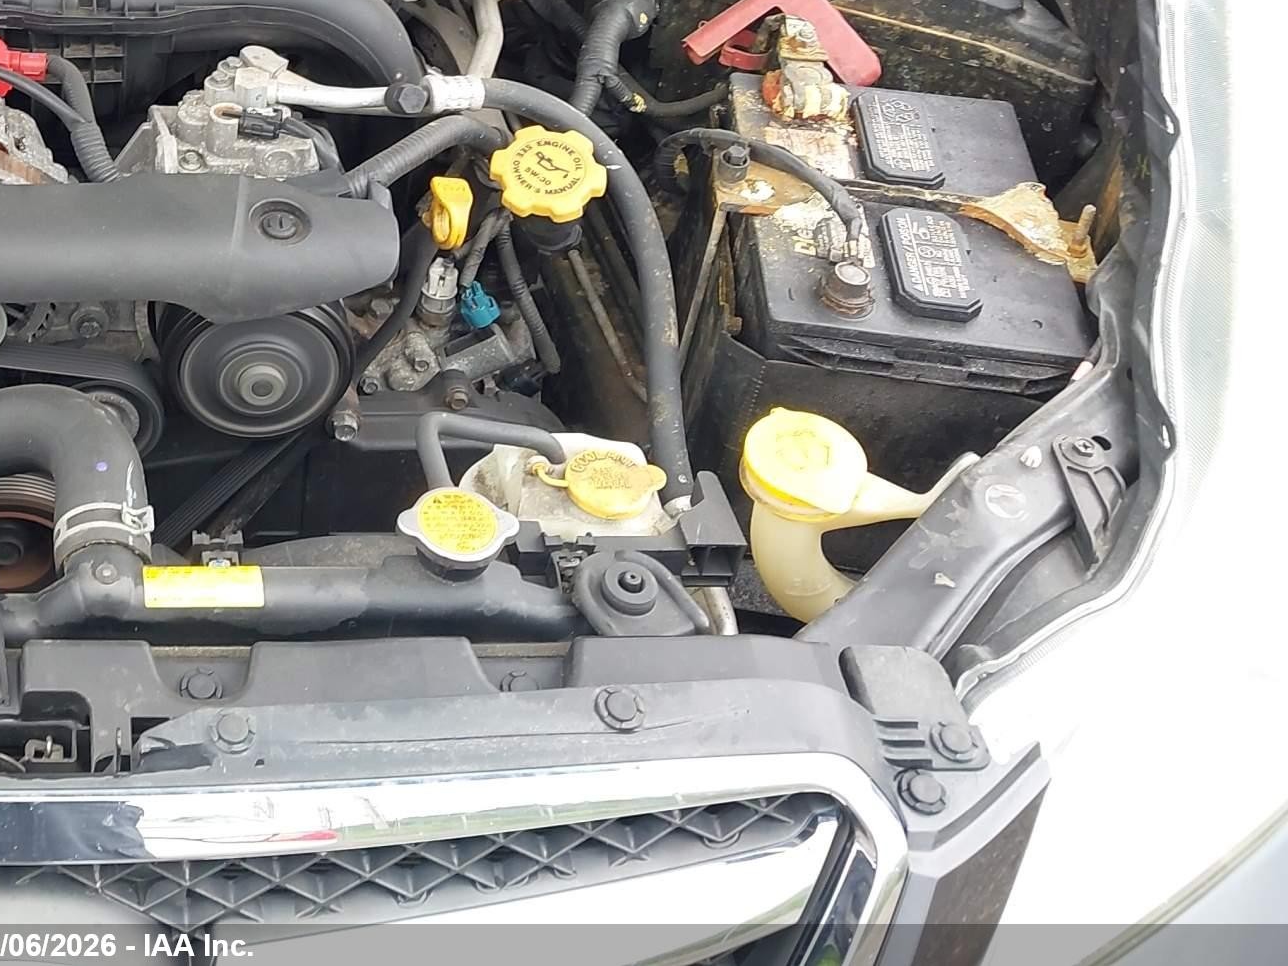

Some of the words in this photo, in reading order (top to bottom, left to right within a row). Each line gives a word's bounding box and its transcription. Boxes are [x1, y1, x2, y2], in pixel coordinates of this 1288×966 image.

[536, 140, 576, 156] ENGINE
[573, 156, 583, 171] OIL
[544, 177, 581, 195] MANUAL
